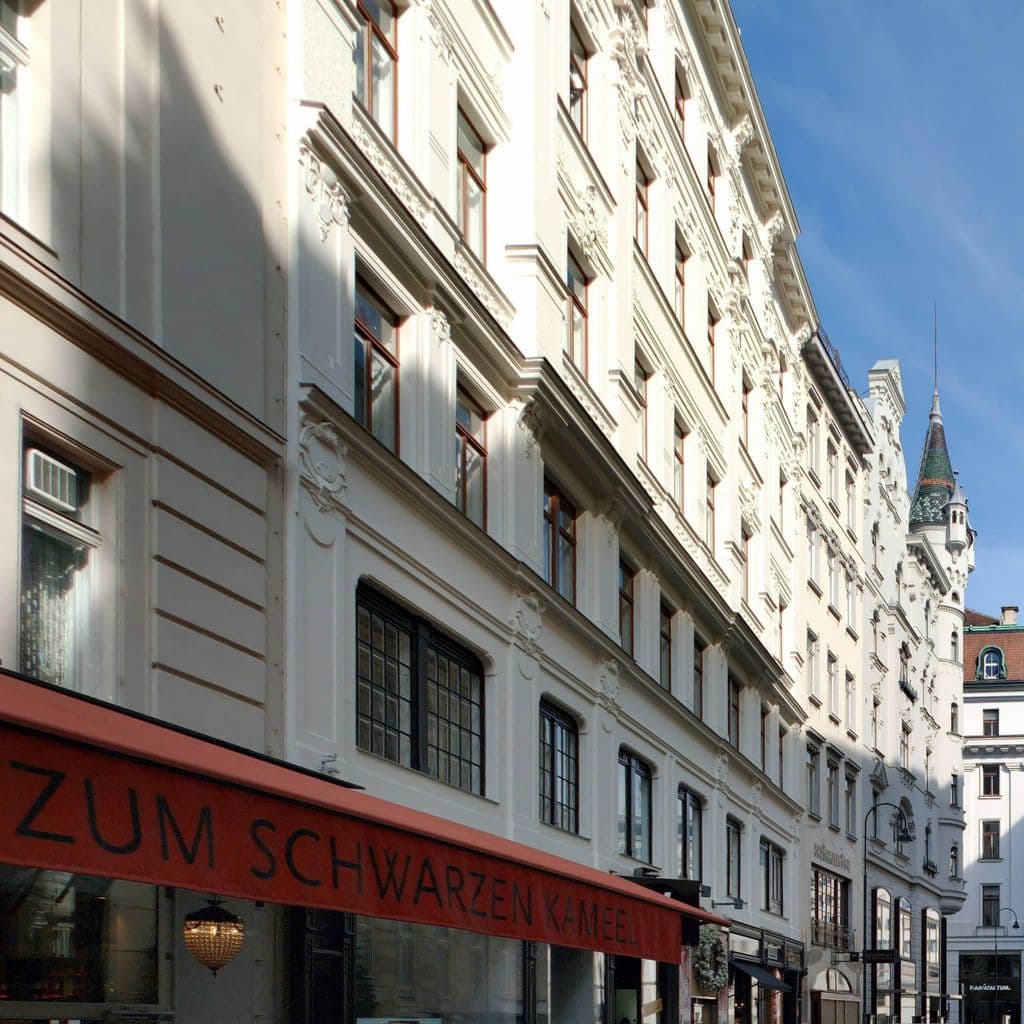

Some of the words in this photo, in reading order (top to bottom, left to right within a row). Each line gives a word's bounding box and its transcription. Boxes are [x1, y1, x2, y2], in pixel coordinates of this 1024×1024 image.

[9, 759, 215, 869] ZUM
[249, 818, 534, 927] SCHWARZEN
[545, 890, 638, 946] KAMEEL
